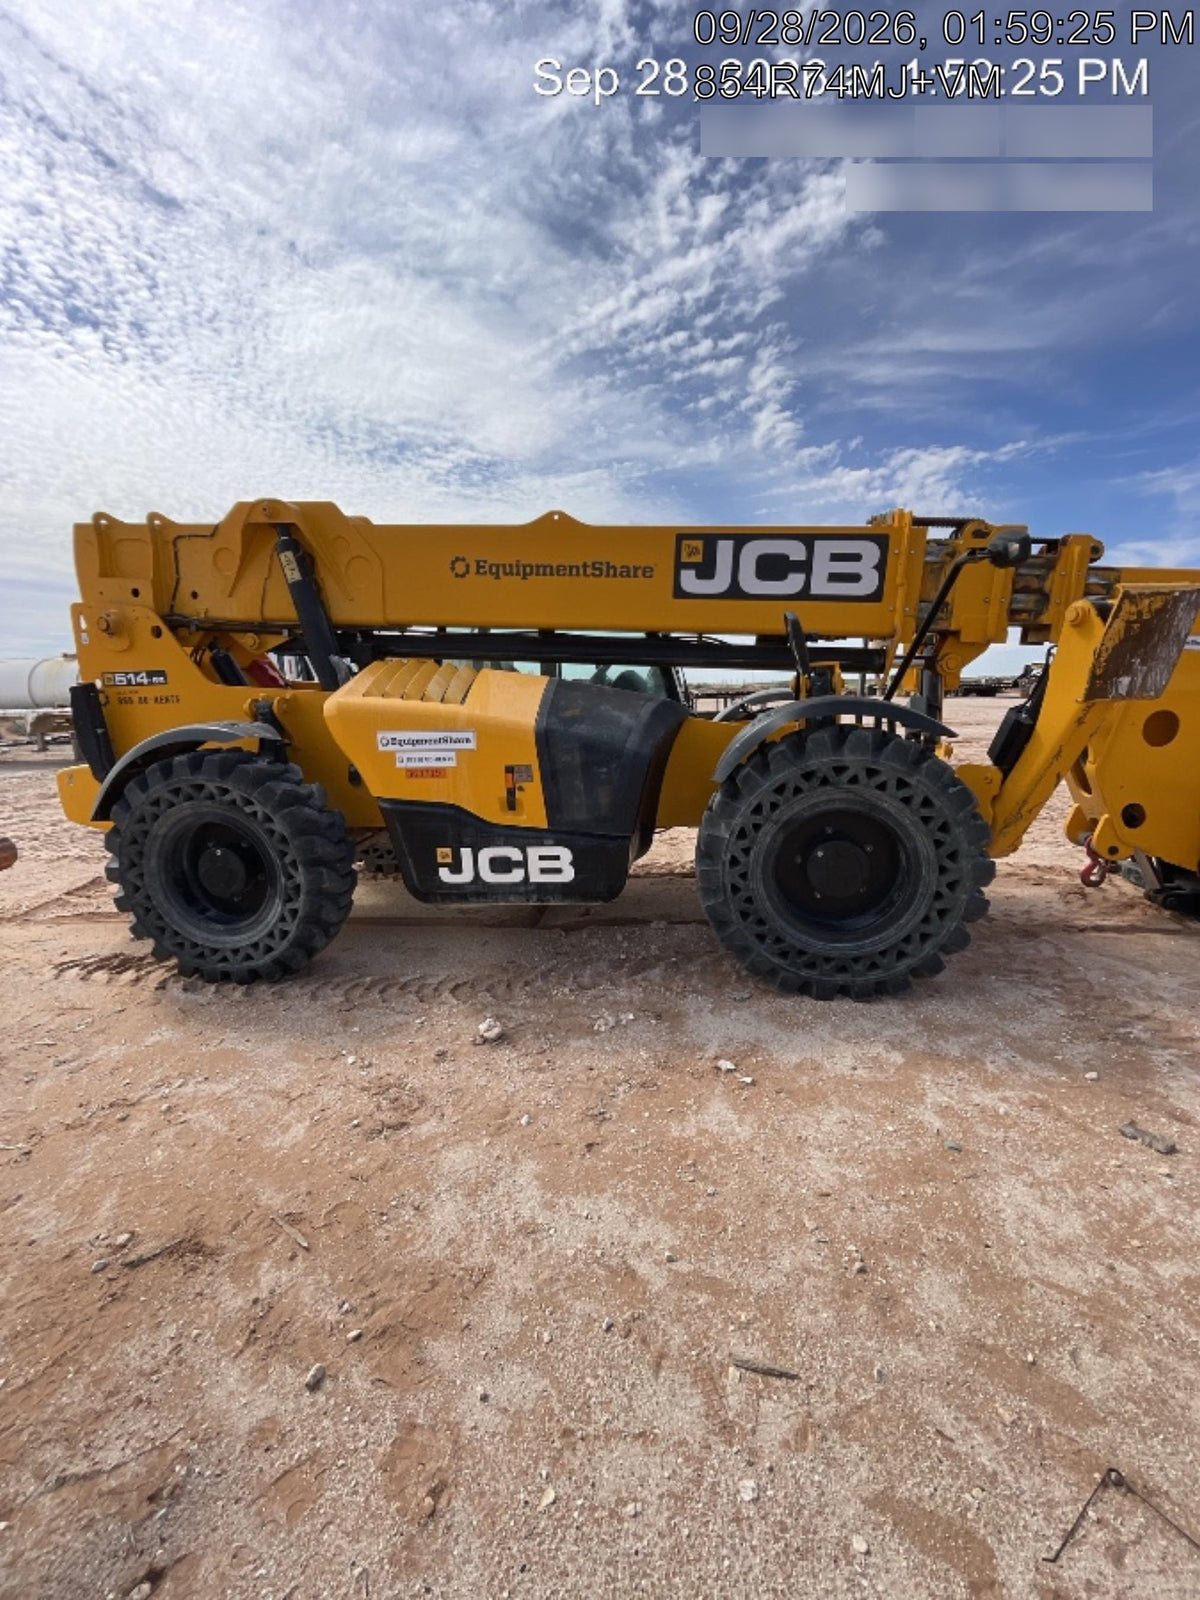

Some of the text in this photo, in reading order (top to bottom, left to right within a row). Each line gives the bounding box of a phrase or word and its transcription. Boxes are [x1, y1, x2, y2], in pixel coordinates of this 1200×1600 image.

[475, 559, 655, 580] EquipmentShare
[679, 539, 881, 596] JCB
[438, 846, 575, 883] JCB
